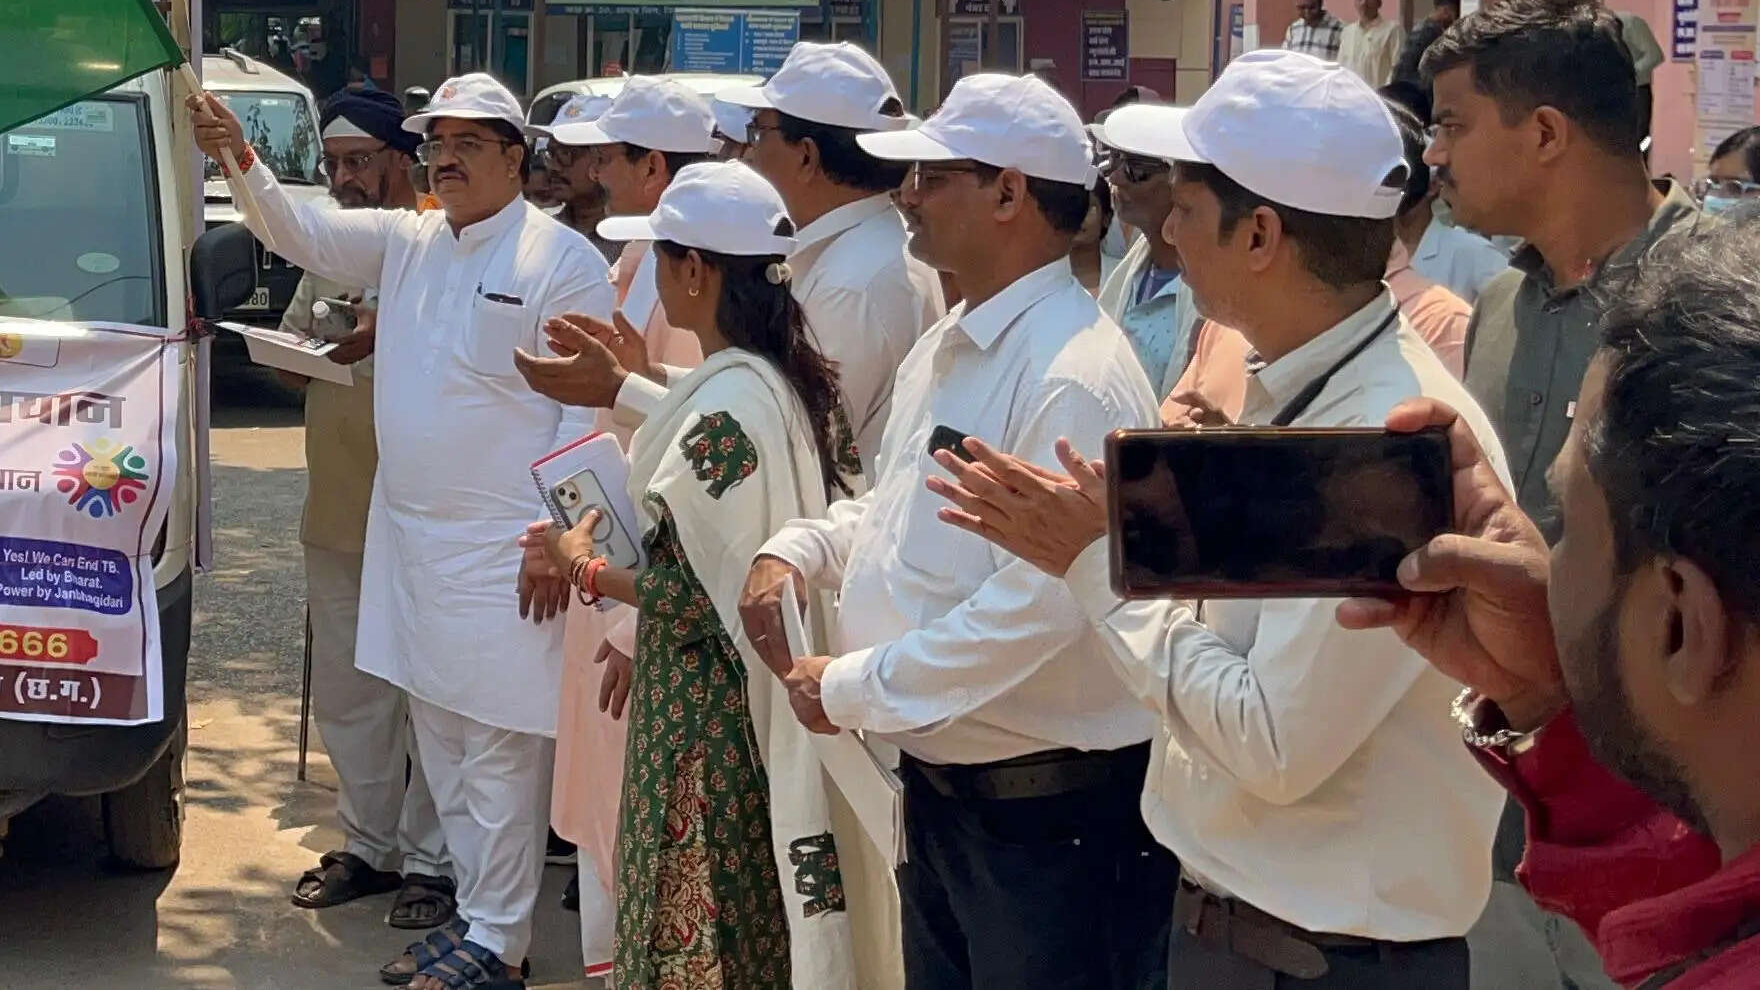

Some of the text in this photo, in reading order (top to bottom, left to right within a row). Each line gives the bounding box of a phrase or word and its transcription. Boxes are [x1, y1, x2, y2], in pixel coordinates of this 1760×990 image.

[3, 548, 28, 563] Yes!
[31, 551, 50, 565] We
[53, 553, 75, 568] Can
[77, 557, 98, 571] End
[21, 567, 43, 581] Led
[46, 570, 61, 585] by
[36, 587, 52, 601] by
[54, 587, 124, 609] Janbhagidari
[14, 671, 102, 709] (छ.ग.)
